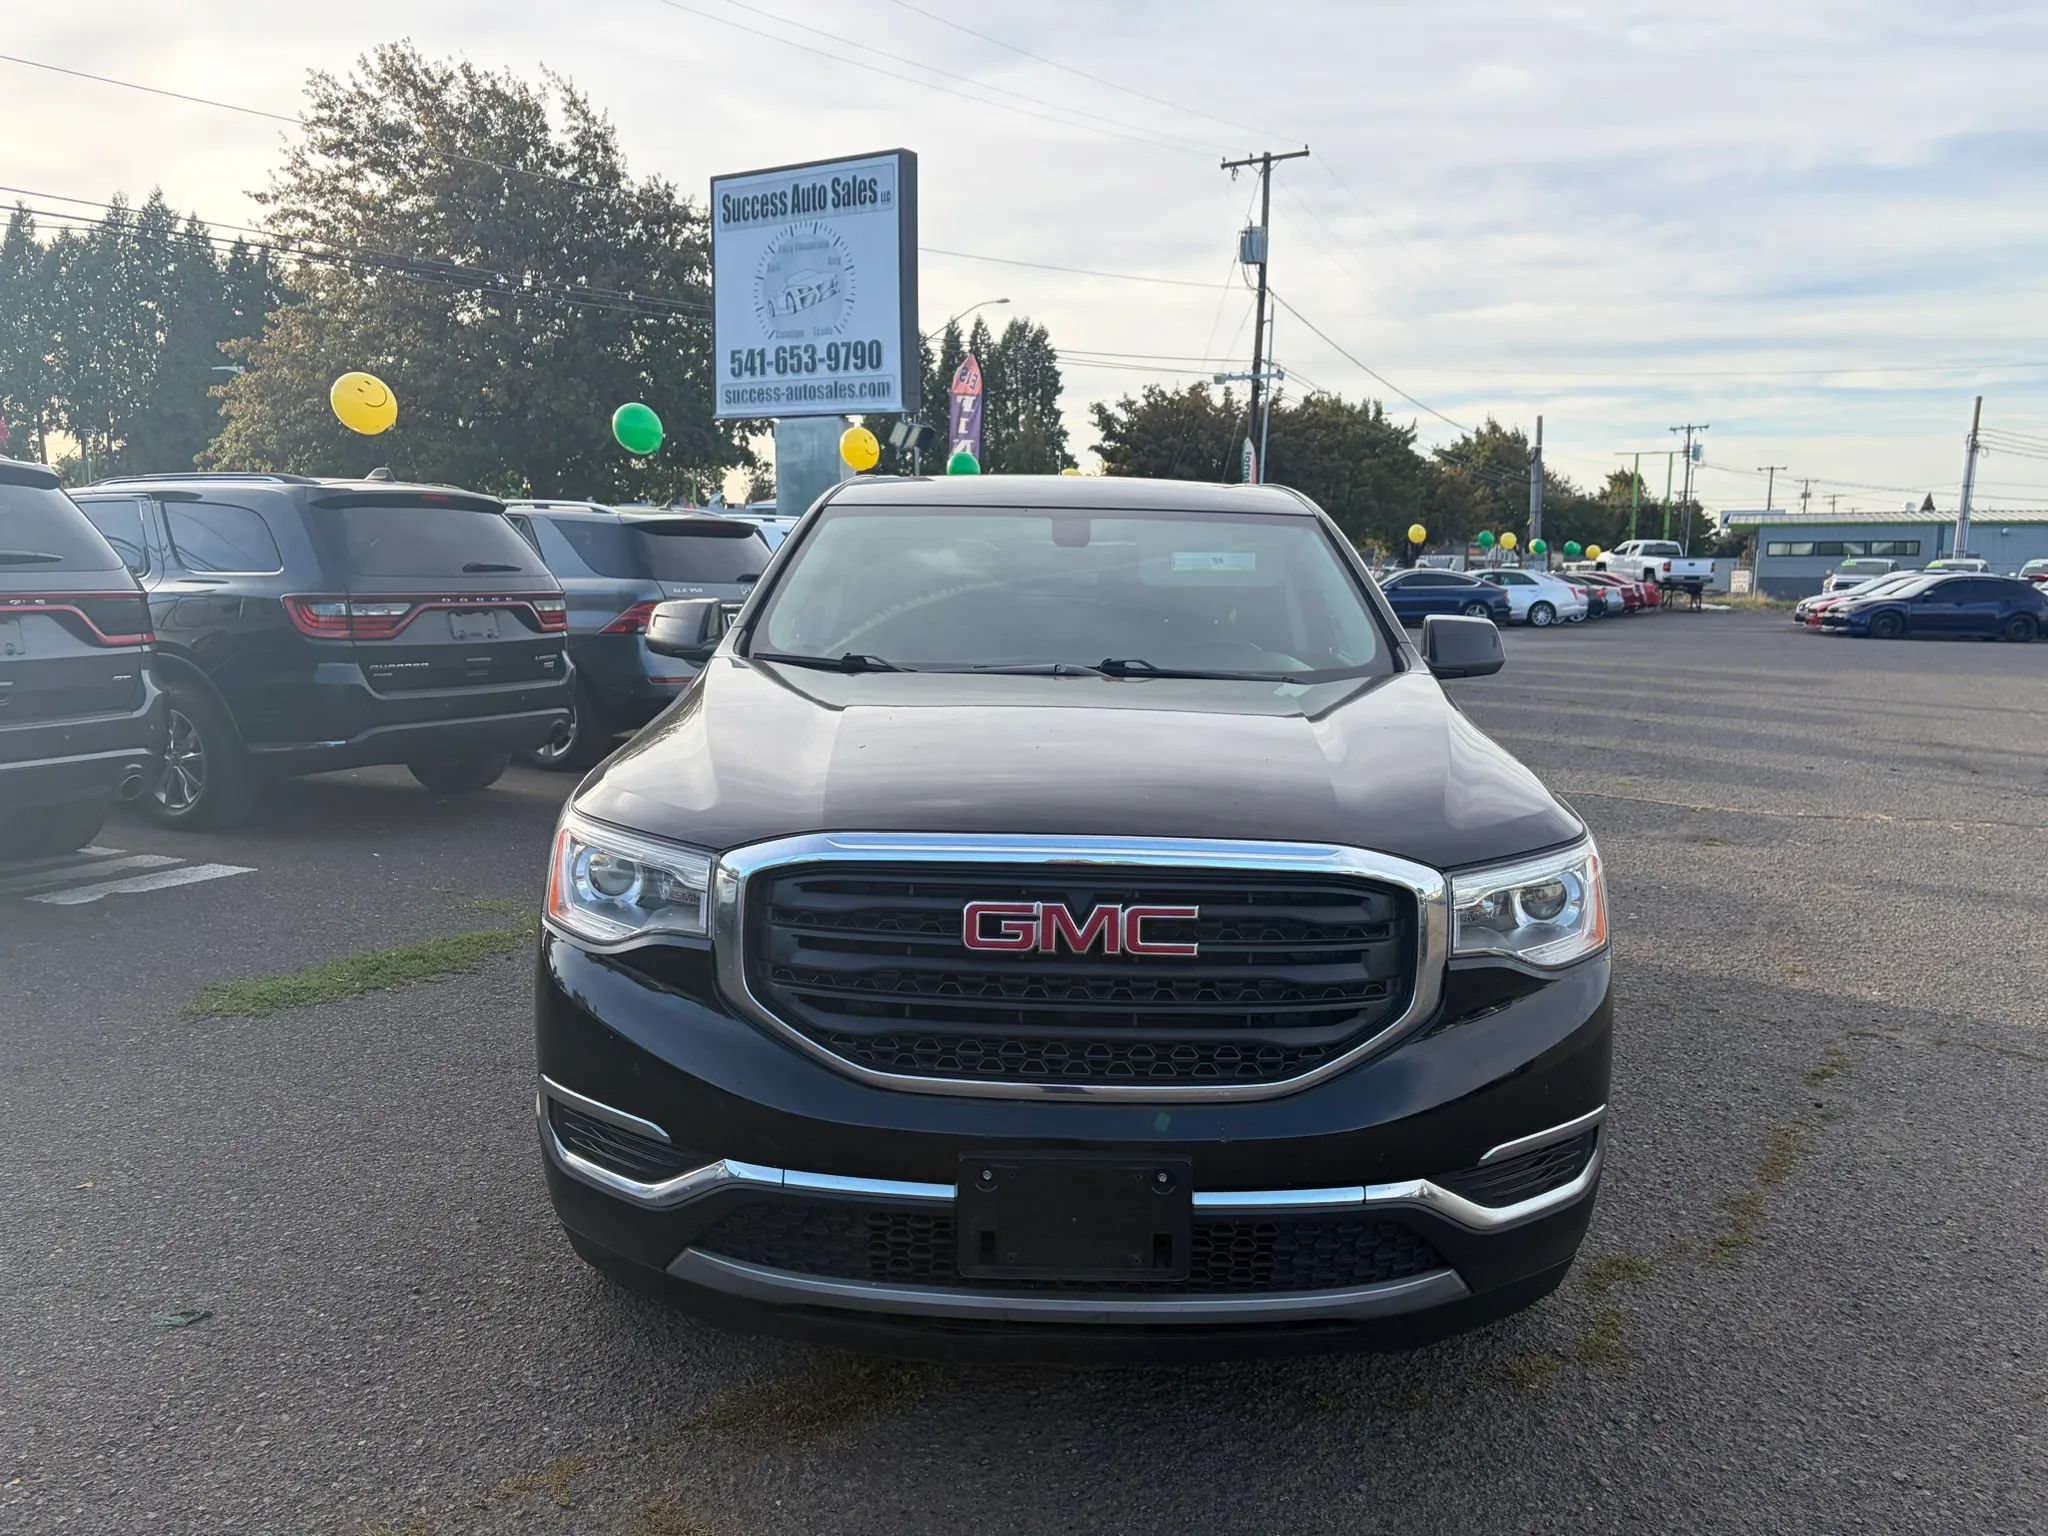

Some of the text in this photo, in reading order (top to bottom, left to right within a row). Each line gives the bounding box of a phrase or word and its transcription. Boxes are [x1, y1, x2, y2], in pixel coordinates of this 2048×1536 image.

[722, 190, 788, 224] Success
[791, 183, 827, 215] Auto
[831, 175, 878, 209] Sales
[730, 339, 882, 378] 541-653-9790
[725, 381, 891, 404] success-autosales.com
[963, 900, 1200, 956] GMC
